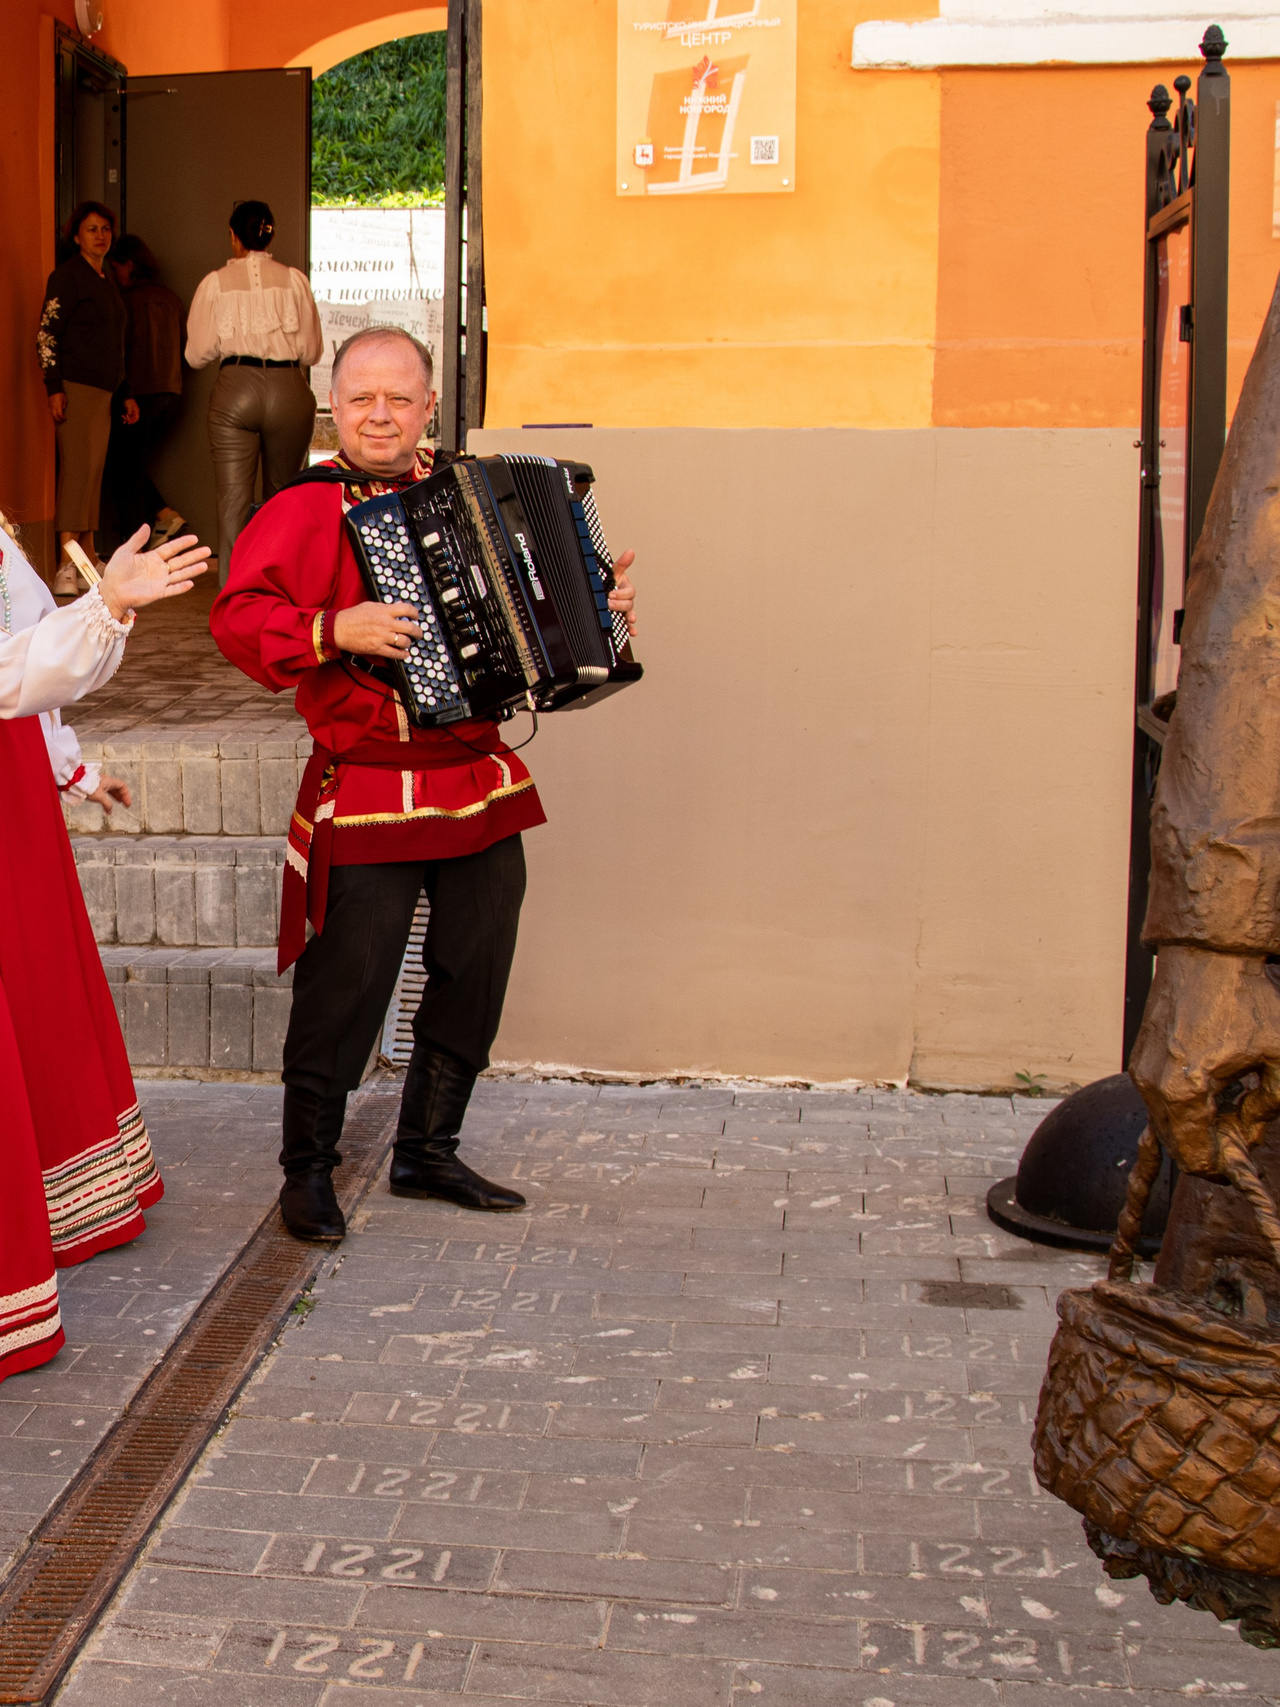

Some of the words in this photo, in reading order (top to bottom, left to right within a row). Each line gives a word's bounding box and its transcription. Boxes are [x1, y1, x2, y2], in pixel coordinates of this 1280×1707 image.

[680, 31, 732, 48] ЦЕНТР
[339, 287, 442, 303] настояще
[514, 532, 539, 583] Roland
[474, 1243, 578, 1265] 1221
[451, 1288, 564, 1313] 1221
[901, 1334, 1020, 1362] 1221
[385, 1398, 512, 1430] 1221
[904, 1390, 1028, 1425] 1221
[348, 1463, 485, 1502] 1221
[906, 1461, 1040, 1497] 1221
[302, 1541, 452, 1582] 1221
[909, 1541, 1056, 1579] 1221
[264, 1630, 425, 1680] 1221
[912, 1622, 1072, 1677] 1221
